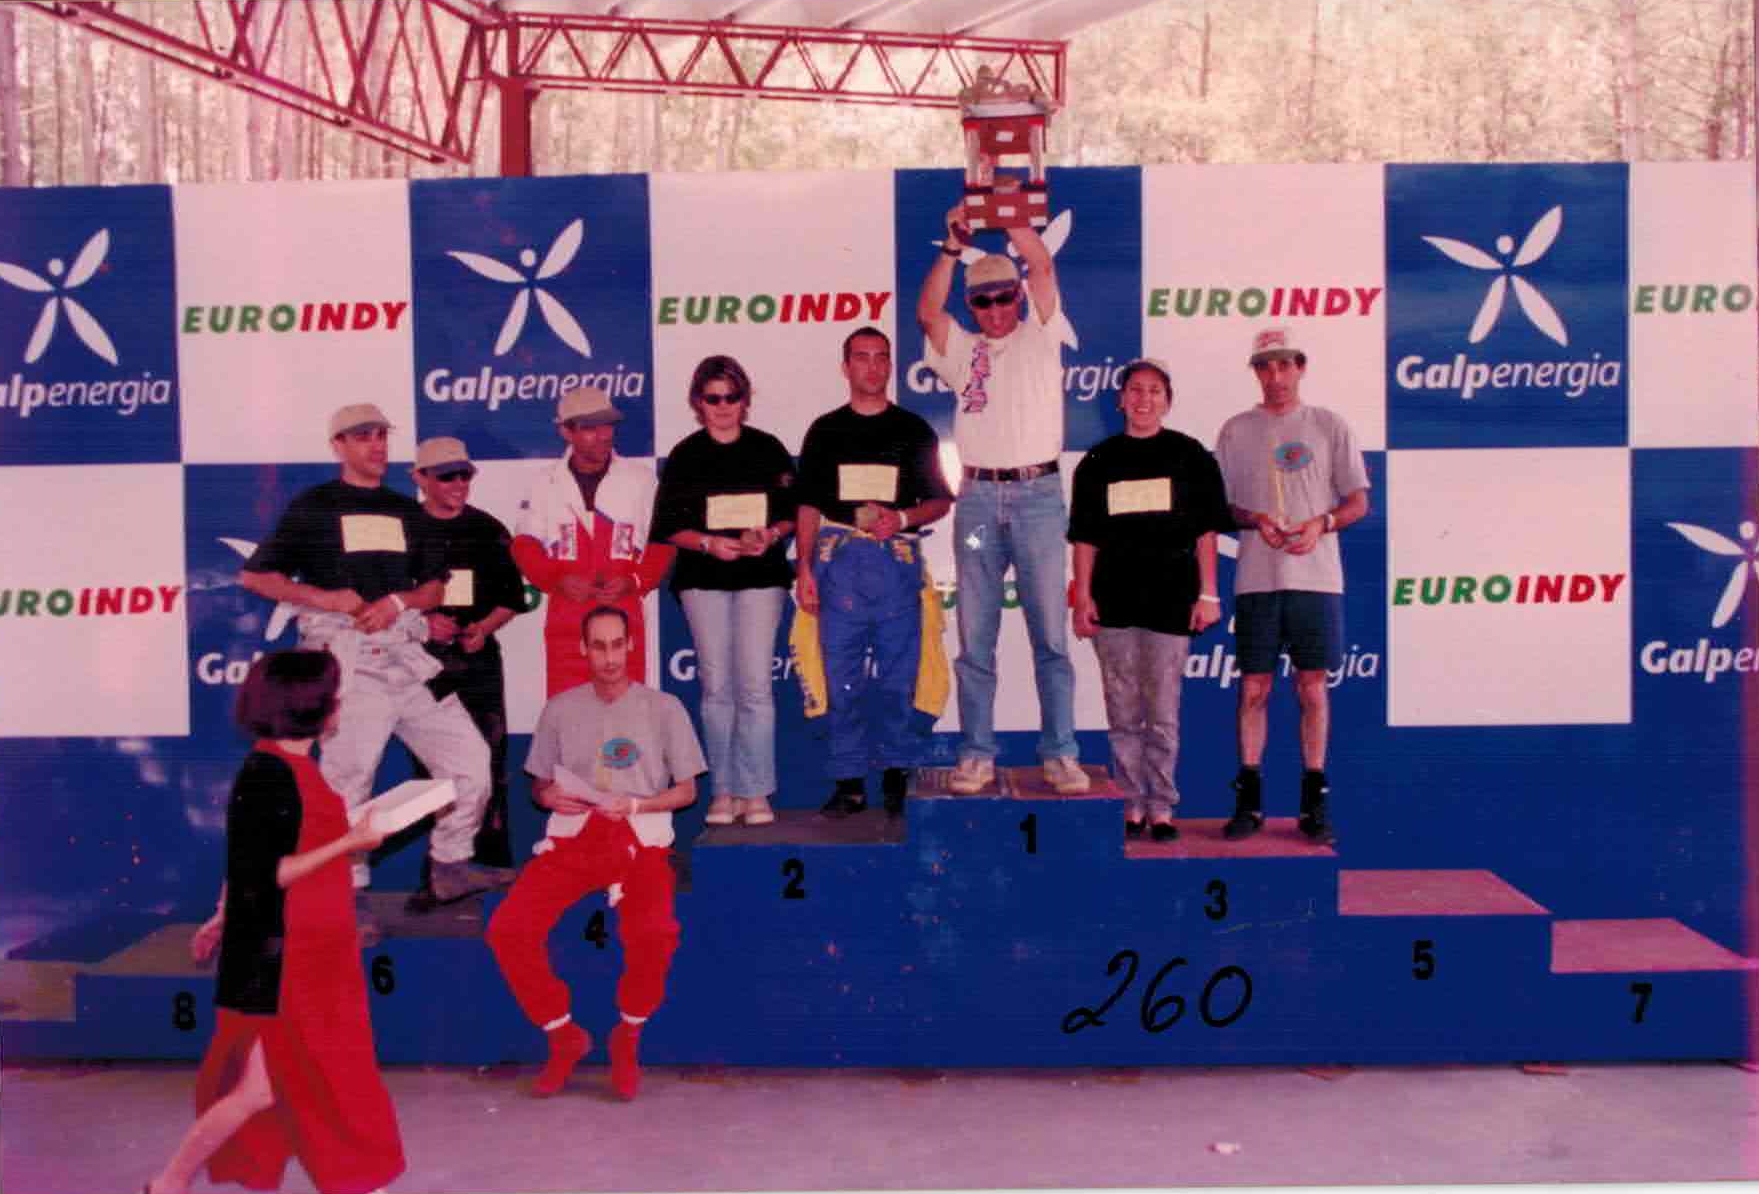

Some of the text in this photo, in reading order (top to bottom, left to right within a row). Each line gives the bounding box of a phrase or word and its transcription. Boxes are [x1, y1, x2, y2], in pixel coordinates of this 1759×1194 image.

[183, 301, 406, 334] EUROINDY
[658, 291, 891, 325] EUROINDY
[1149, 287, 1381, 317] EUROINDY
[1396, 353, 1622, 399] Galpenergia
[1393, 573, 1625, 606] EUROINDY
[1019, 812, 1038, 855] 1
[780, 857, 807, 901] 2
[1203, 877, 1230, 923] 3
[580, 908, 610, 950] 4
[368, 952, 397, 996] 6
[1411, 939, 1437, 982] 5
[171, 989, 198, 1034] 8
[1629, 981, 1653, 1026] 7
